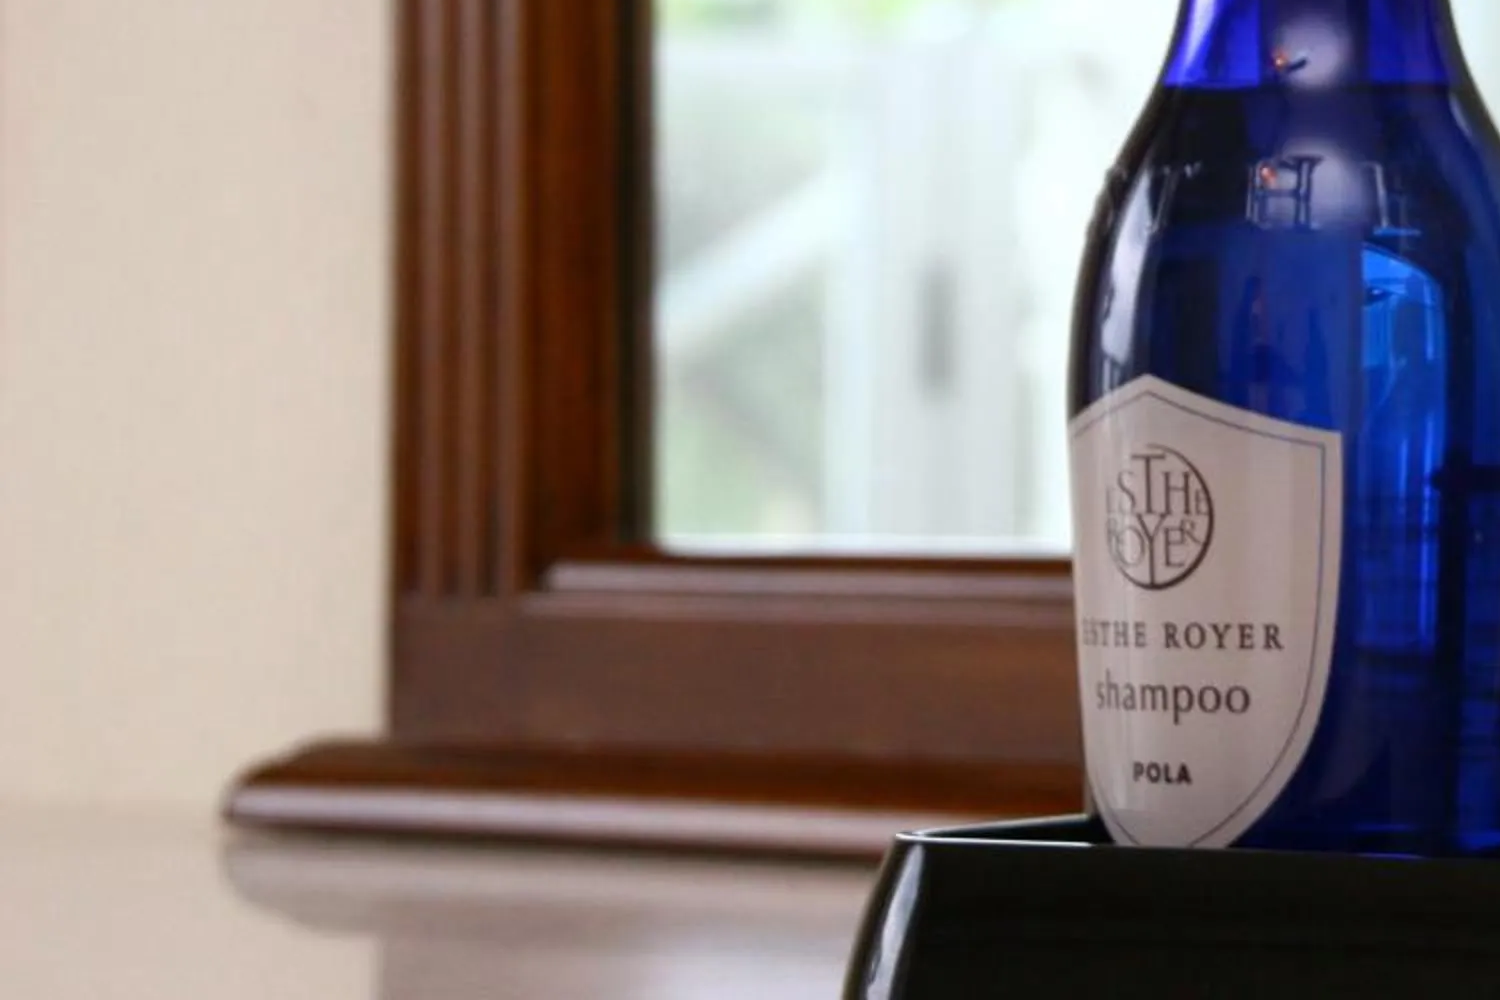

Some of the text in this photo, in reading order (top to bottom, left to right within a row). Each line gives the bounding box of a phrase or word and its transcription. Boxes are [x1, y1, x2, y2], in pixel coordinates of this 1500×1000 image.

[1162, 621, 1285, 652] ROYER
[1096, 668, 1252, 726] shampoo
[1133, 761, 1193, 786] POLA
